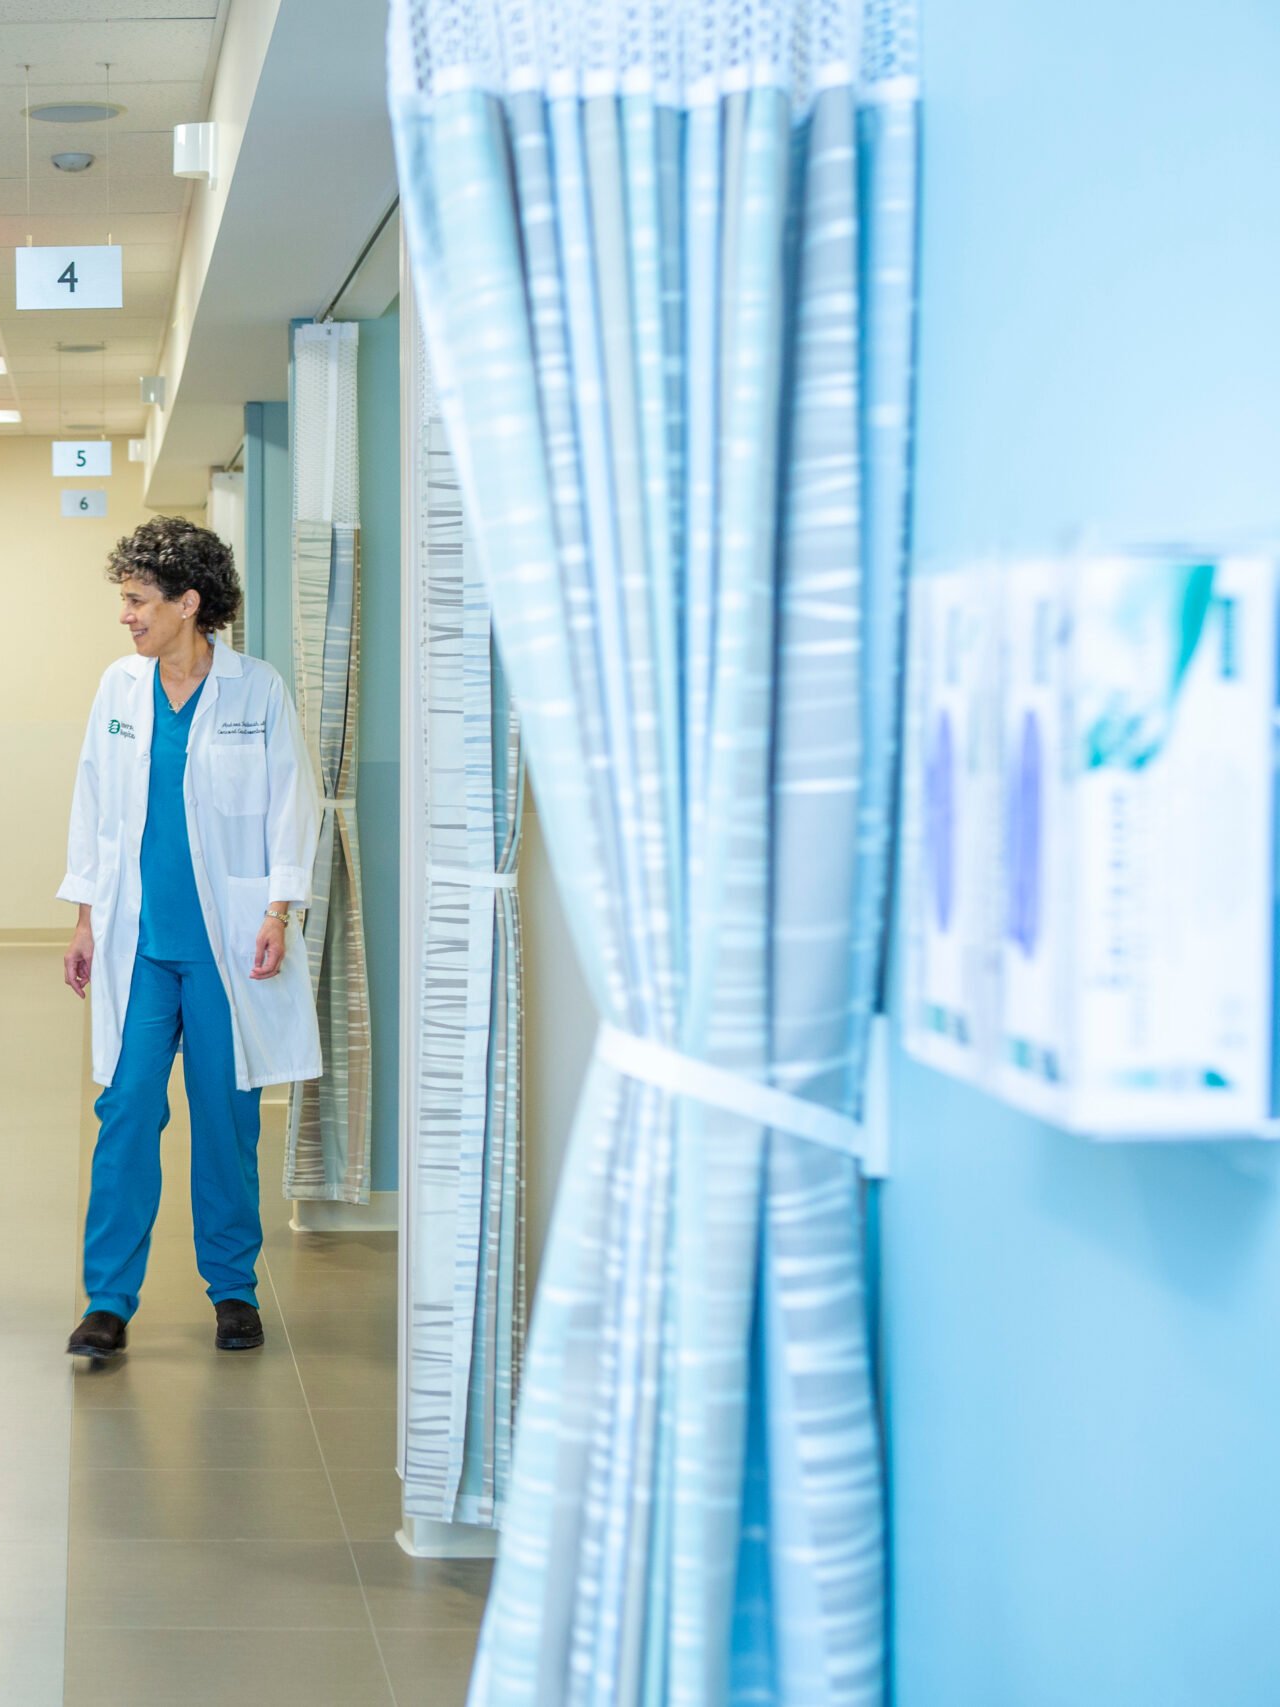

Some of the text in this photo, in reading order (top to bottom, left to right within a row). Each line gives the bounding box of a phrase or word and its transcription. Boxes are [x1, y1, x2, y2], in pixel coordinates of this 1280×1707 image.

[57, 261, 78, 293] 4
[76, 450, 87, 467] 5
[79, 497, 89, 511] 6
